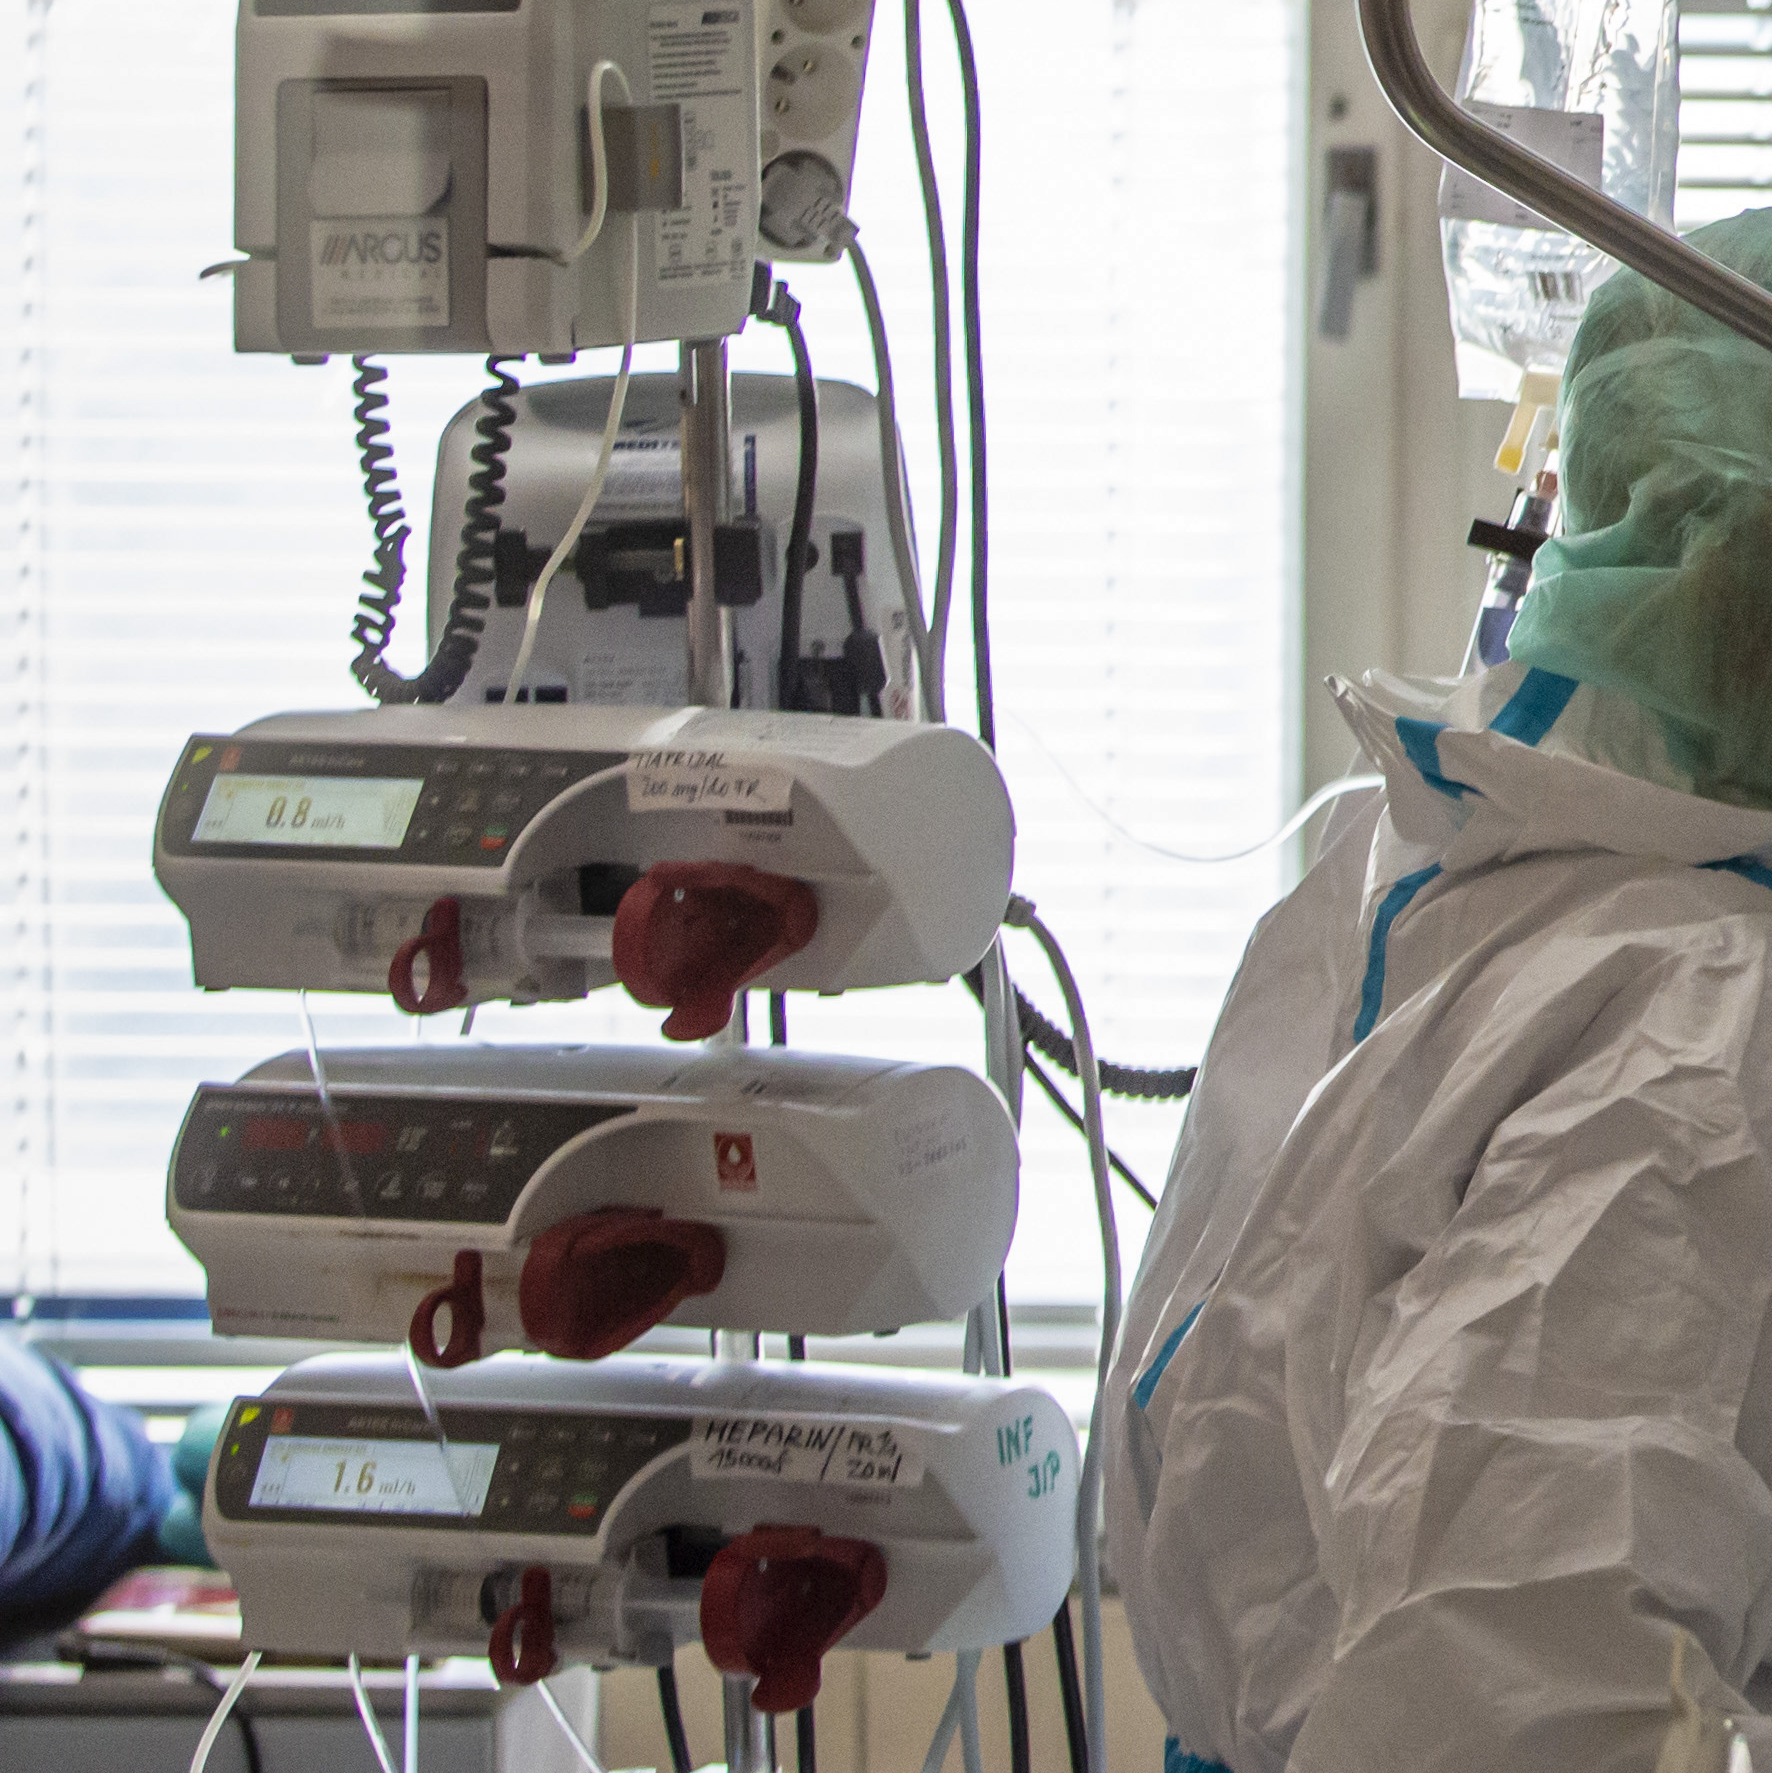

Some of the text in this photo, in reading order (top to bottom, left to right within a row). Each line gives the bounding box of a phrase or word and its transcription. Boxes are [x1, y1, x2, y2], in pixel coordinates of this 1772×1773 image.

[340, 232, 443, 264] ARGUS
[265, 795, 345, 831] 0.8 ml/h
[996, 1414, 1034, 1467] INF
[332, 1459, 418, 1497] 1.6 ml/h
